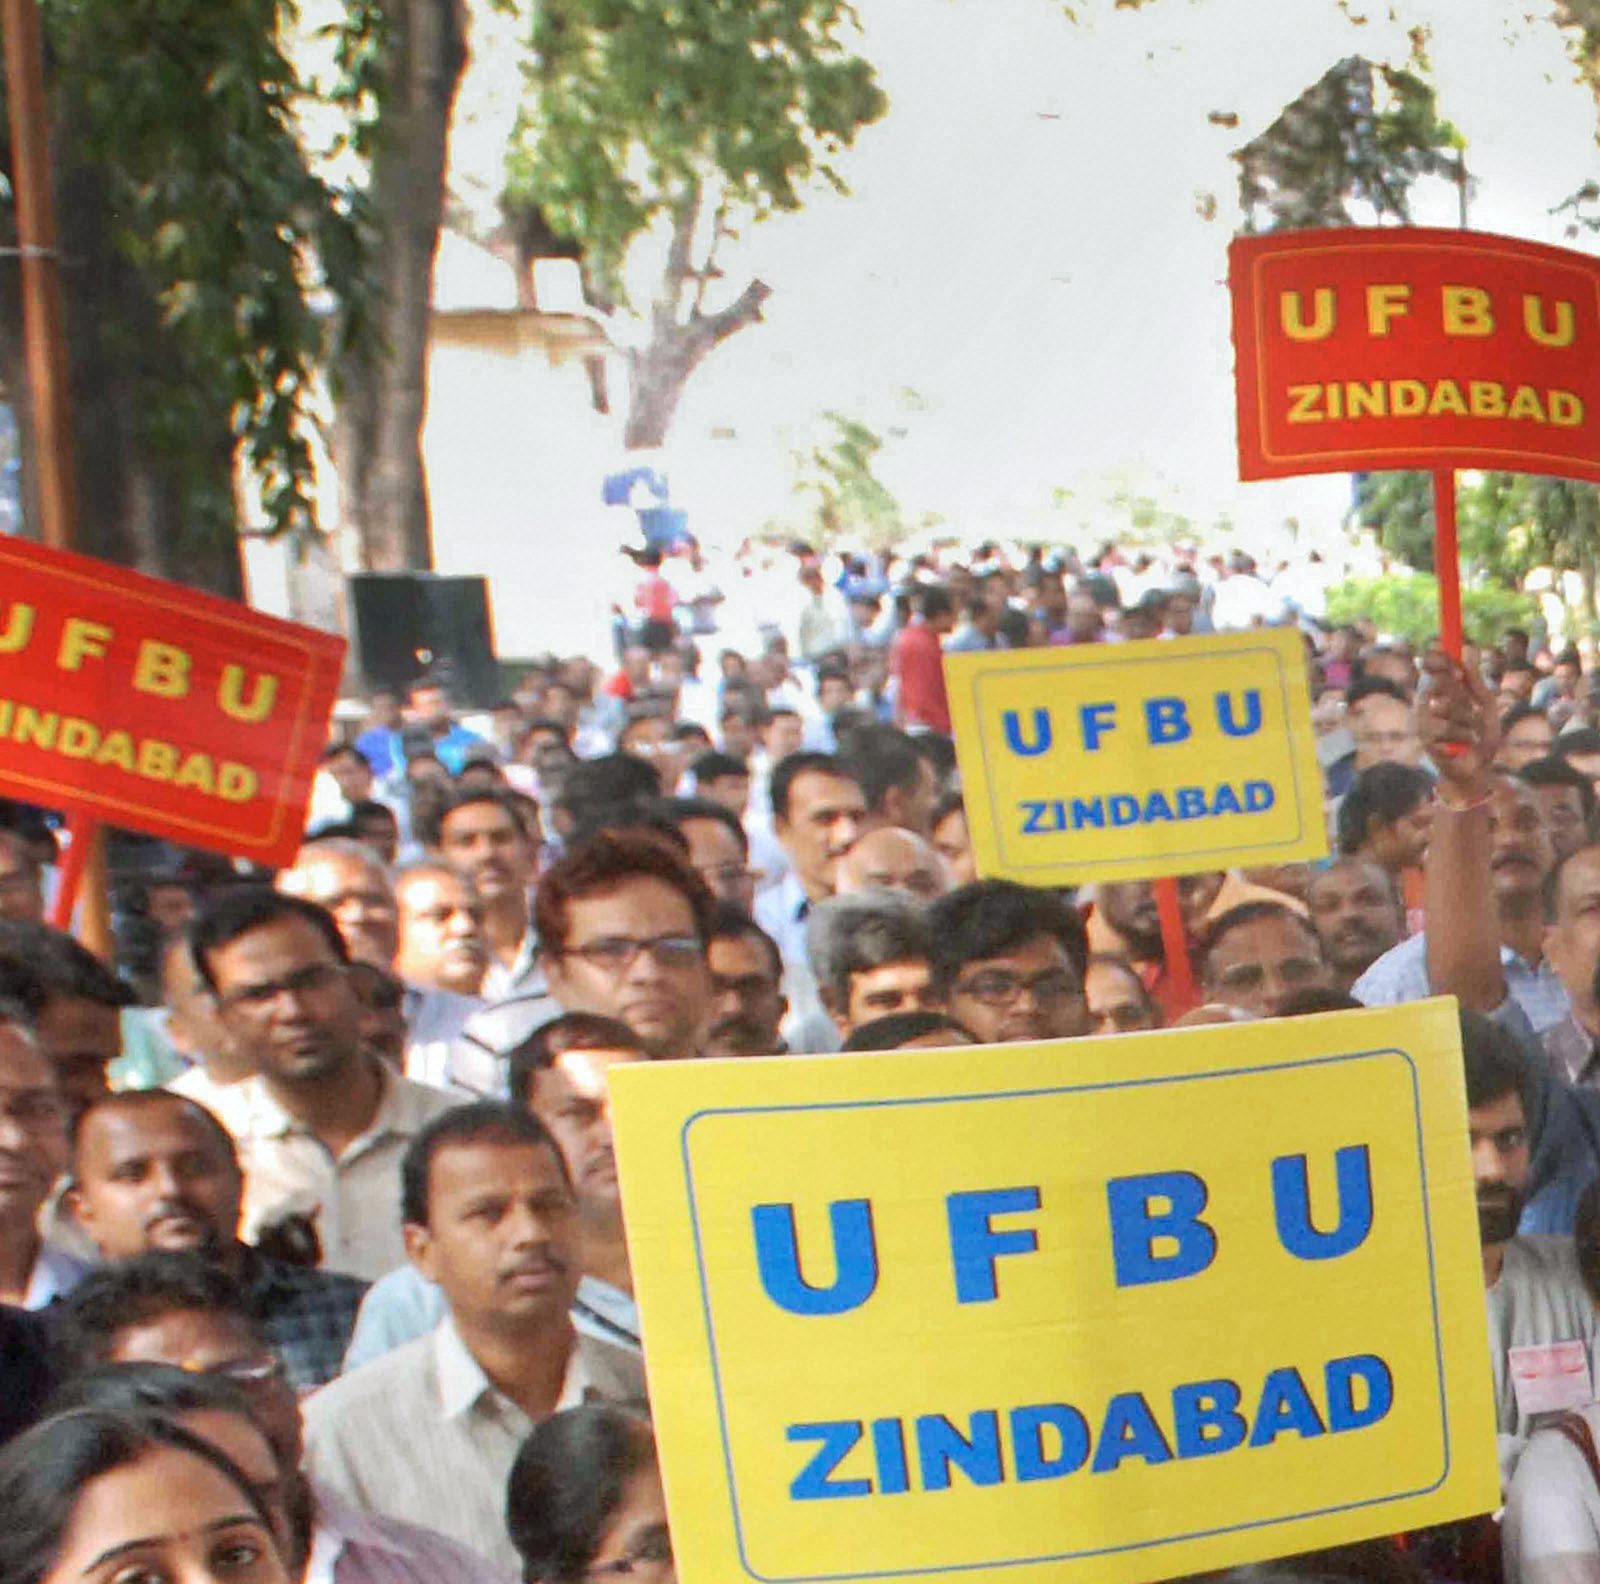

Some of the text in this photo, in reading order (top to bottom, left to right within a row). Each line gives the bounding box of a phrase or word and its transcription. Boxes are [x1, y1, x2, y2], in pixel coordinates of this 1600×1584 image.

[1281, 283, 1577, 348] UFBU
[1287, 379, 1585, 428] ZINDABAD
[0, 699, 260, 804] INDABAD
[1001, 686, 1266, 758] UFBU
[1018, 778, 1276, 836] ZINDABAD
[749, 1143, 1375, 1317] UFBU
[784, 1352, 1395, 1503] ZINDABAD
